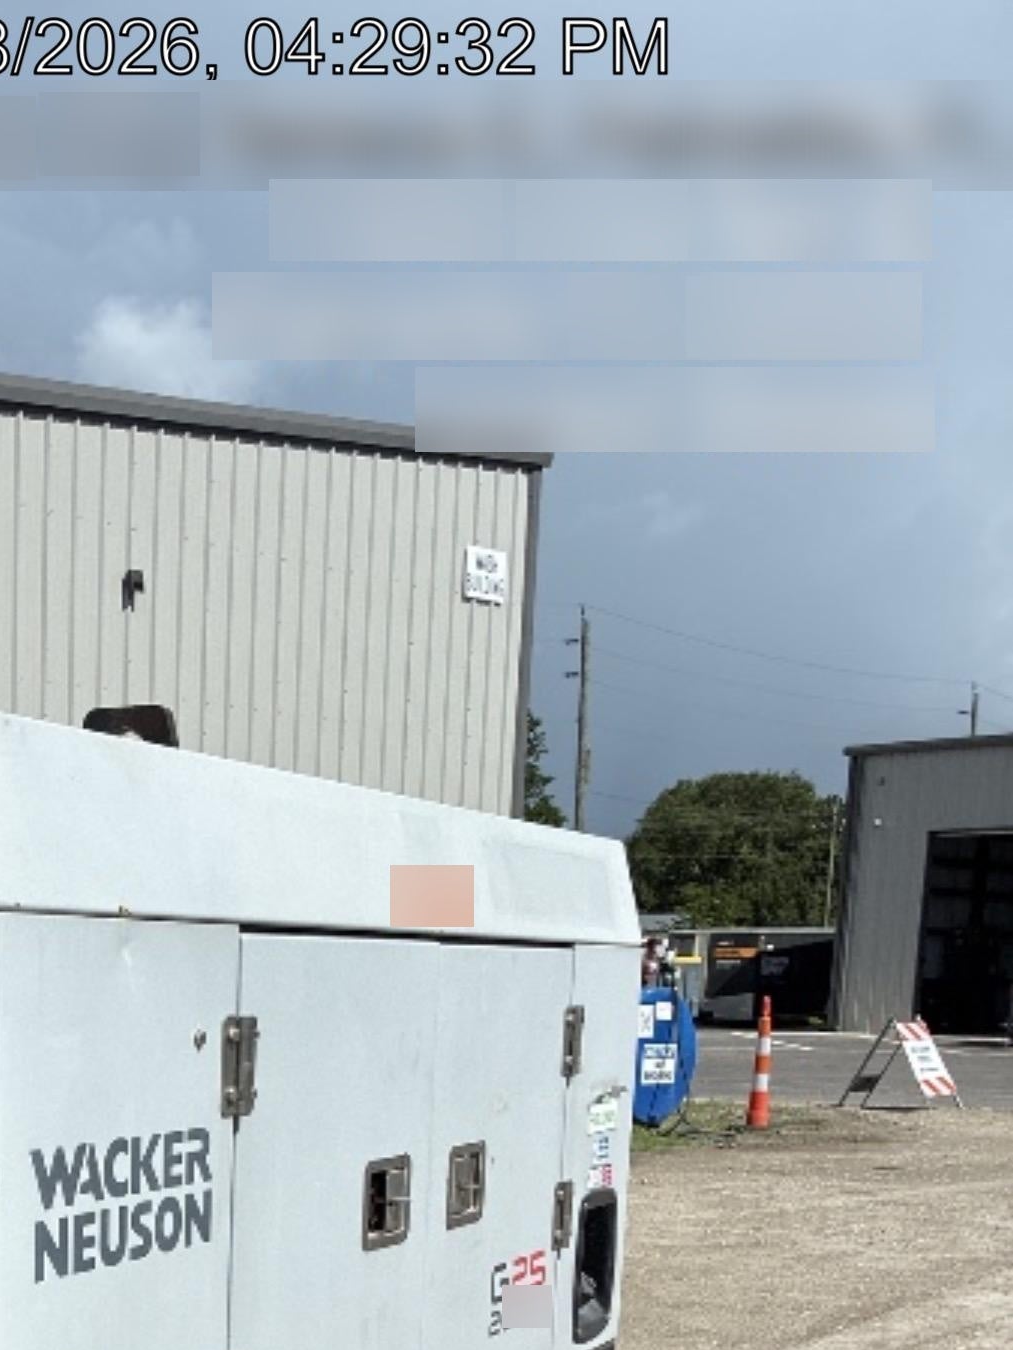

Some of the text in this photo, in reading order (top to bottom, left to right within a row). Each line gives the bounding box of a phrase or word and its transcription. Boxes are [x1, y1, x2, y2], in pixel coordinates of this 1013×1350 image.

[29, 1127, 212, 1210] WACKER
[34, 1188, 212, 1284] NEUSON
[490, 1250, 547, 1305] G25
